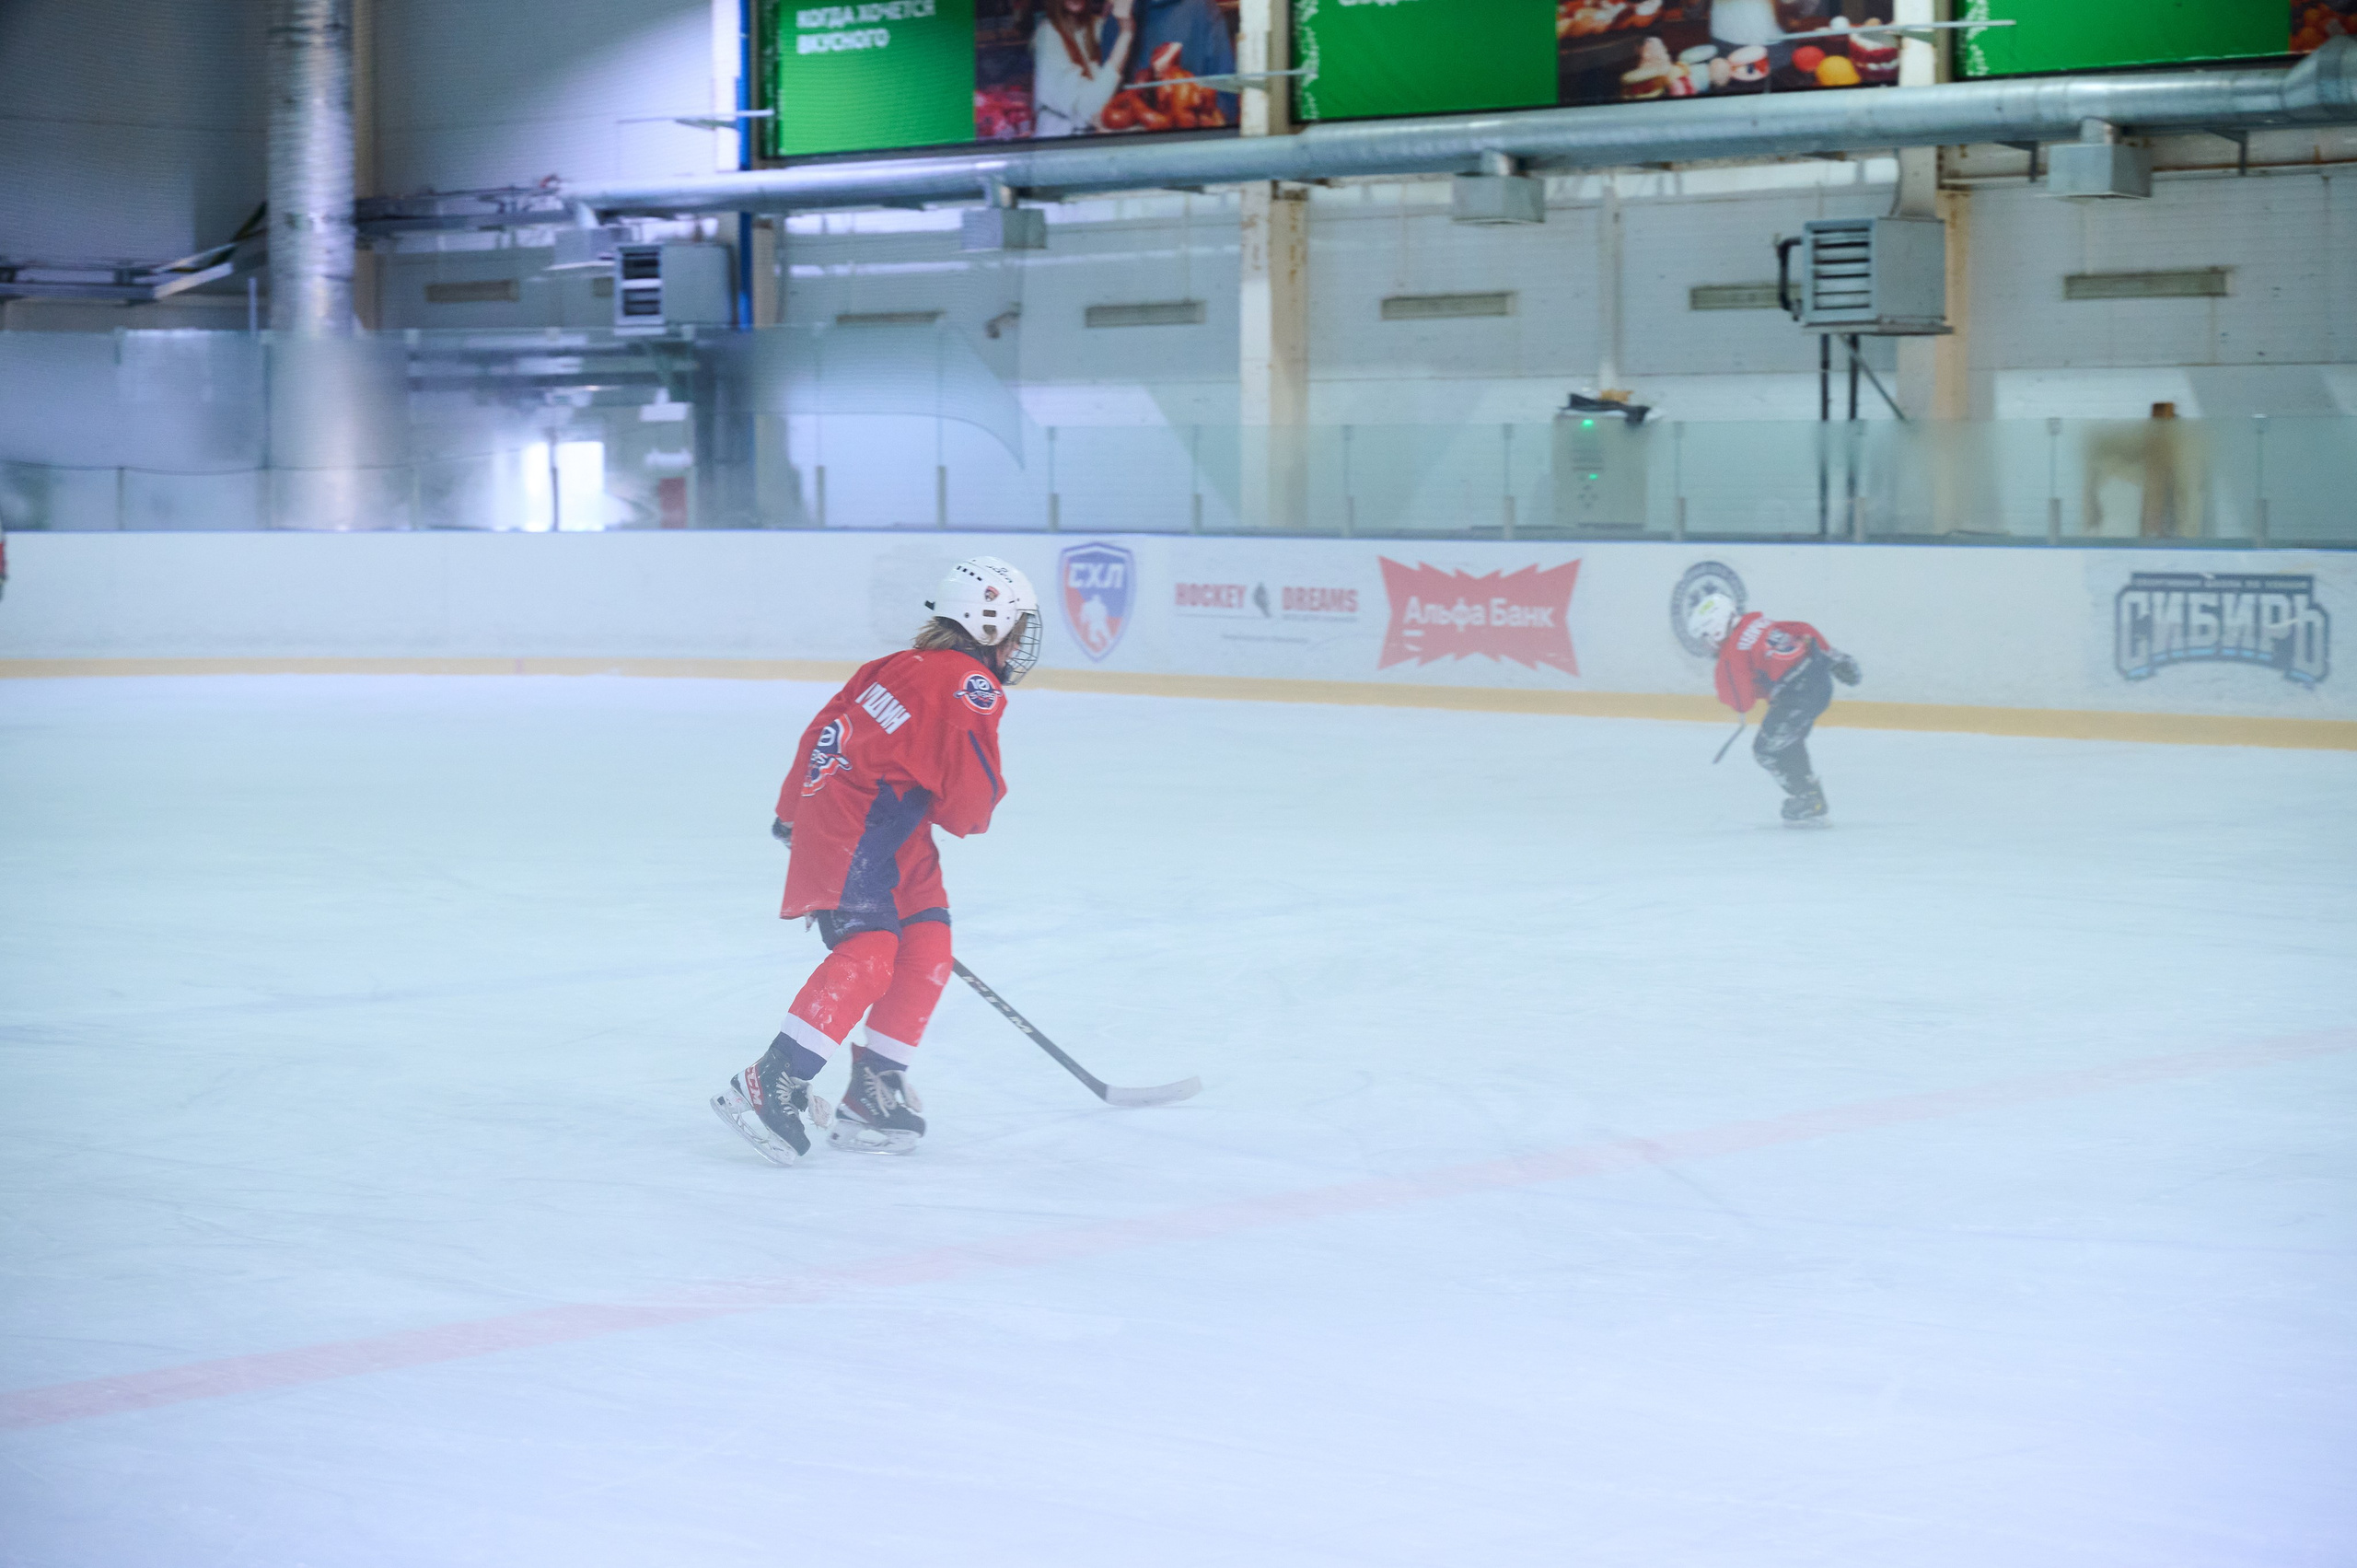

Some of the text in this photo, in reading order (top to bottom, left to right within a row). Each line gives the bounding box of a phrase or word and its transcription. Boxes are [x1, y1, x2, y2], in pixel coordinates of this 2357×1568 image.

[1069, 563, 1125, 588] СХЛ
[1175, 582, 1360, 613] HOCKEY DREAMS
[1402, 596, 1556, 633] Альфа Банк
[2118, 587, 2328, 679] СИБИРЬ
